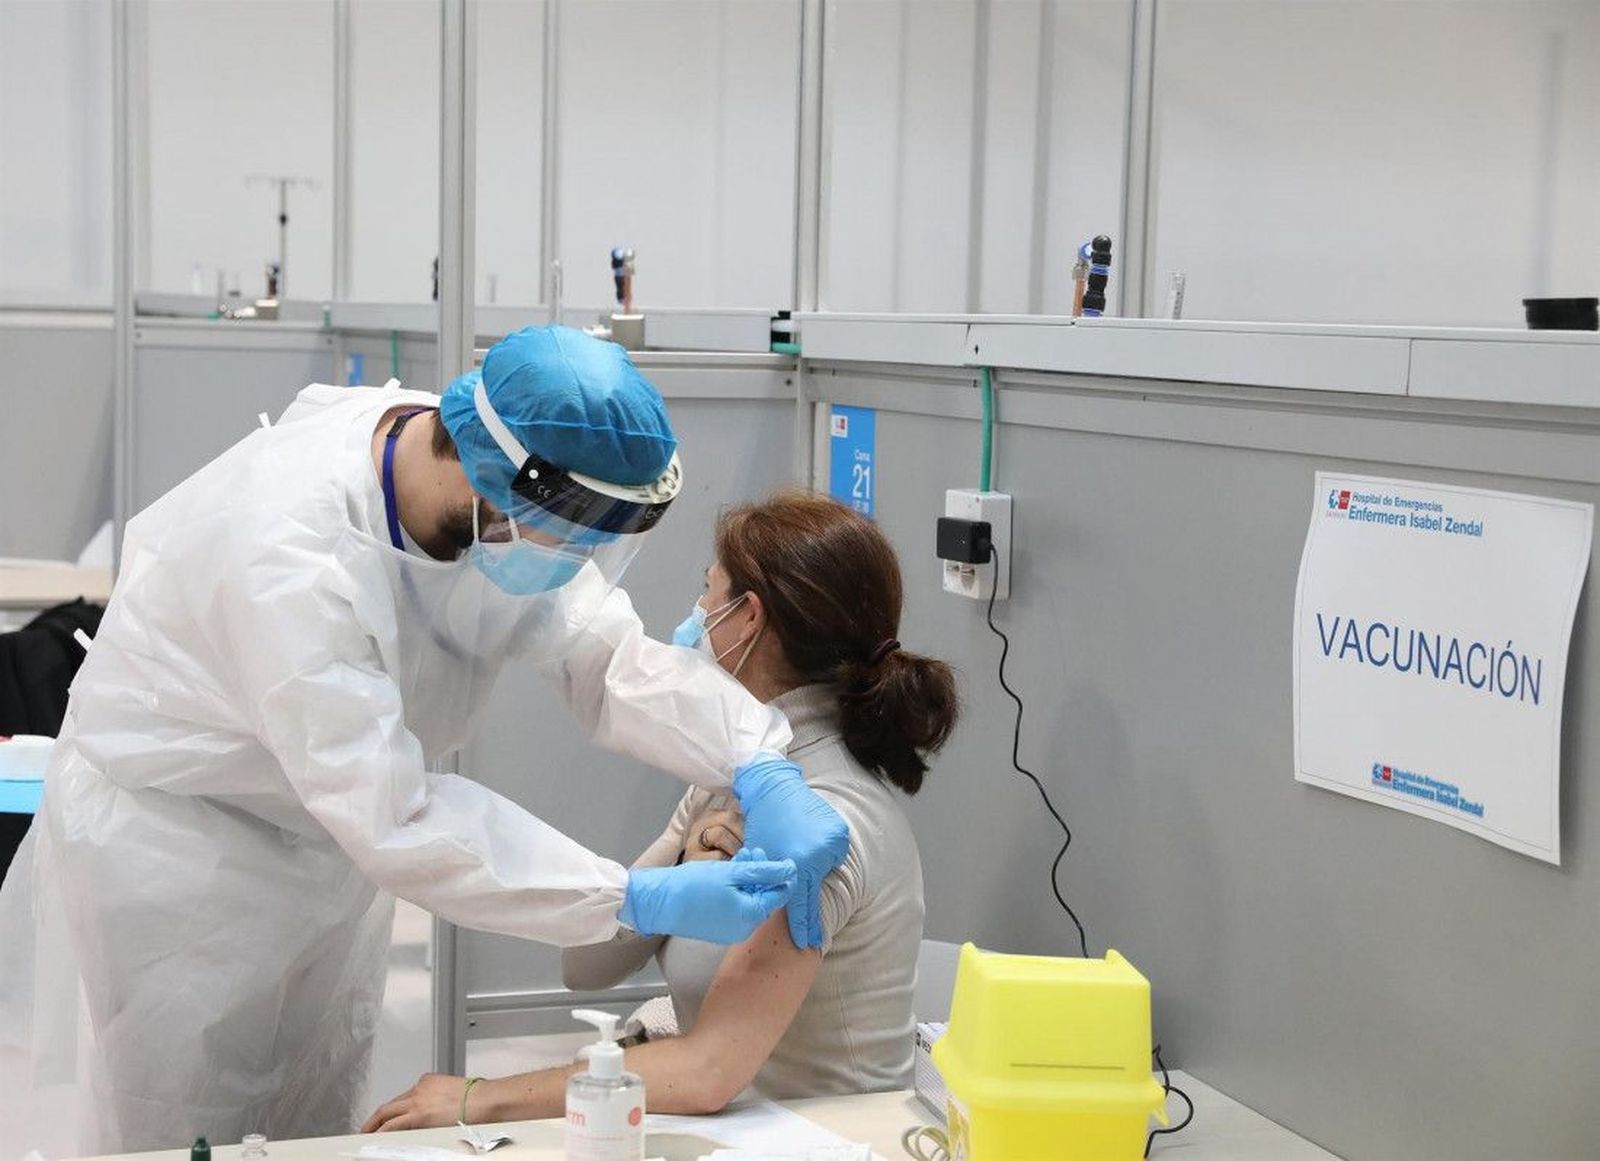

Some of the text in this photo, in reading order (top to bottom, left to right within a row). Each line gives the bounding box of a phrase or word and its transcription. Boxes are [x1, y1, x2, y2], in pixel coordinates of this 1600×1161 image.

[852, 464, 871, 499] 21
[1352, 491, 1443, 513] Hospital de Emergencias
[1348, 505, 1484, 537] Enfermera Isabel Zendal
[1316, 613, 1542, 706] VACUNACIÓN
[1392, 779, 1435, 801] Enfermera
